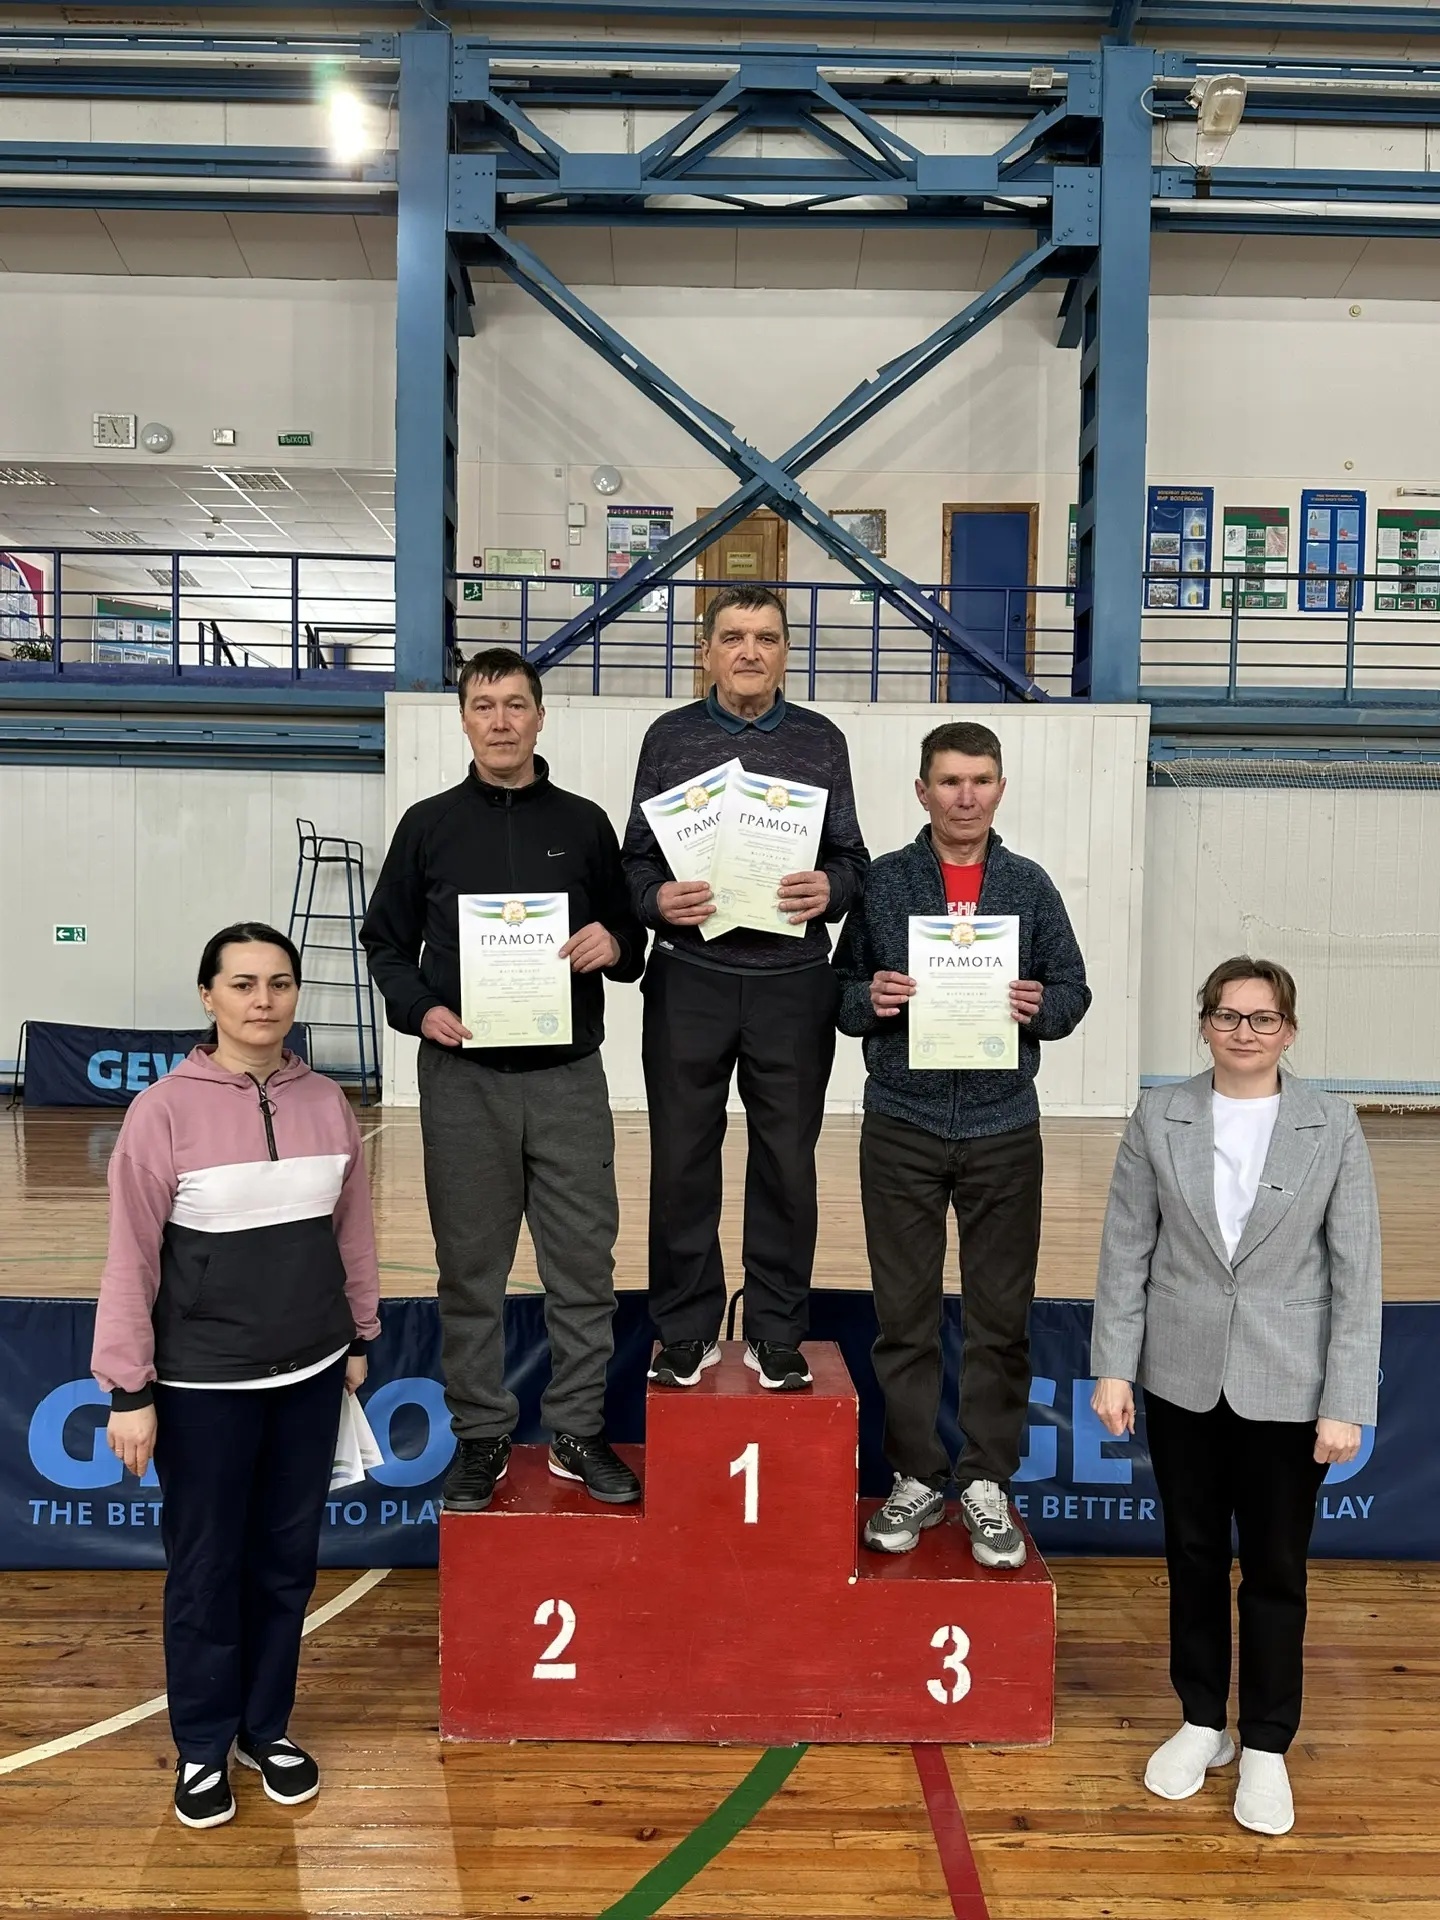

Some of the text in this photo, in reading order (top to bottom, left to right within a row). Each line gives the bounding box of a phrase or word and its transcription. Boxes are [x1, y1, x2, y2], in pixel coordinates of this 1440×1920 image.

[280, 435, 309, 445] ВЫХОД
[676, 811, 721, 842] ГРАМ
[739, 812, 808, 837] ГРАМОТА
[481, 933, 555, 946] ГРАМОТА
[929, 956, 1003, 968] ГРАМОТА
[87, 1050, 187, 1091] GE
[729, 1442, 759, 1525] 1
[28, 1499, 445, 1526] THE BET TO PLA
[1042, 1495, 1156, 1521] BETTER
[1315, 1495, 1375, 1520] LAY
[532, 1598, 577, 1681] 2
[926, 1625, 972, 1705] 3
